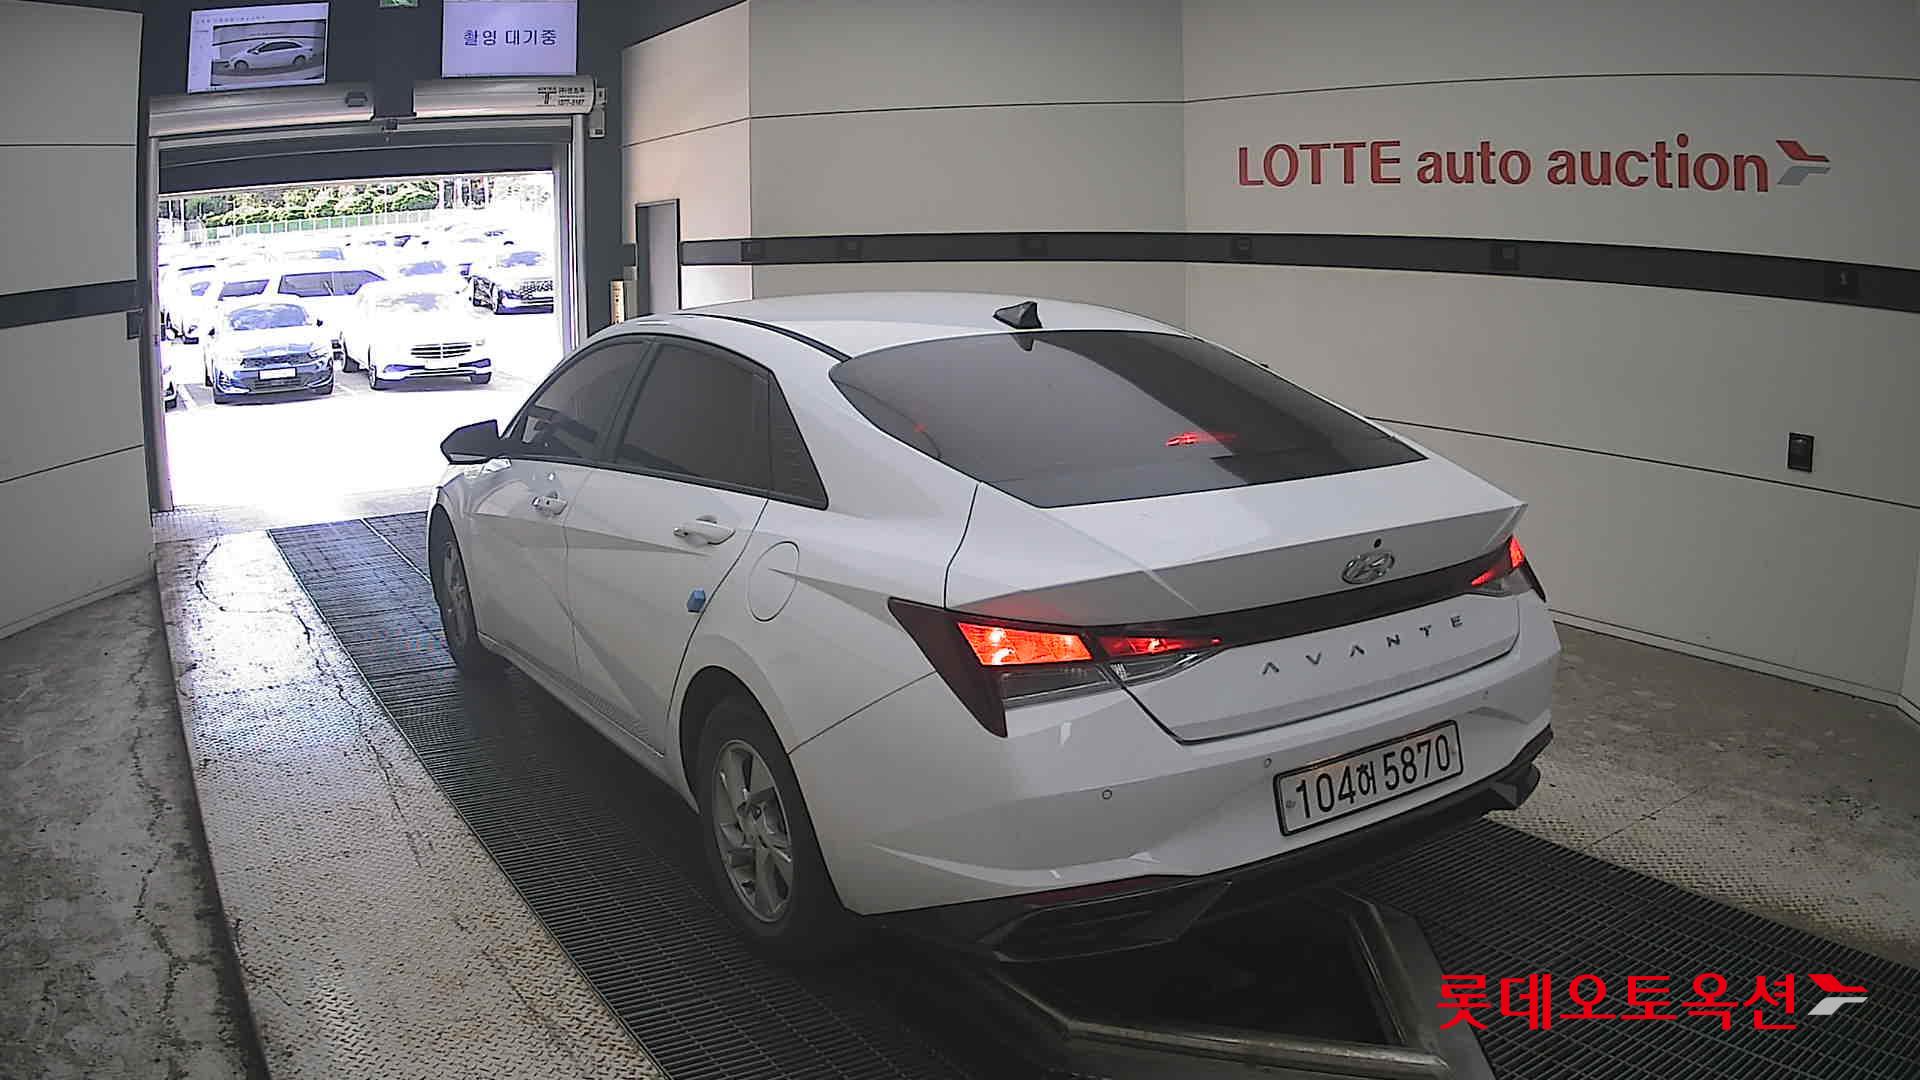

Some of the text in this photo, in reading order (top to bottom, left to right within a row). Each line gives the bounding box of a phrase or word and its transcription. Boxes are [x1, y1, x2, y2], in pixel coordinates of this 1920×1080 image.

[463, 29, 558, 46] 촬영 대기중
[1238, 132, 1769, 193] LOTTE auto auction
[1262, 615, 1463, 675] AVANTE
[1383, 734, 1451, 791] 5870
